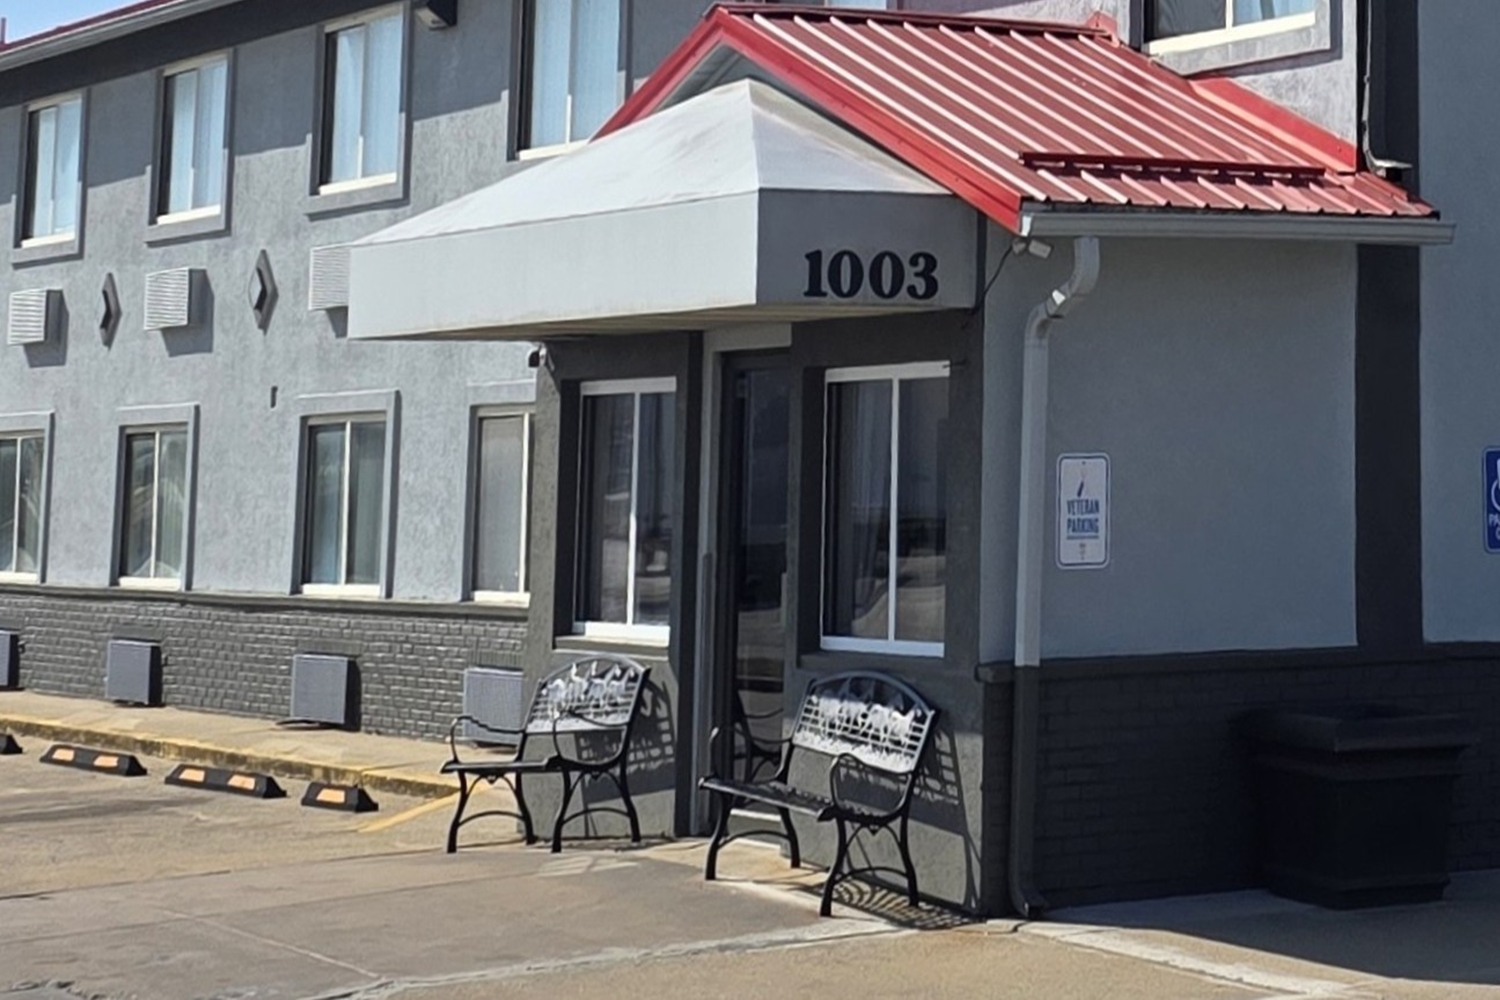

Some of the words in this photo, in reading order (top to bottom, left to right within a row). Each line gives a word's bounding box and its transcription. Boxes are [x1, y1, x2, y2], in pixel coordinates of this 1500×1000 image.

[803, 249, 939, 300] 1003
[1067, 499, 1100, 515] VETERAN
[1067, 517, 1100, 534] PARKING
